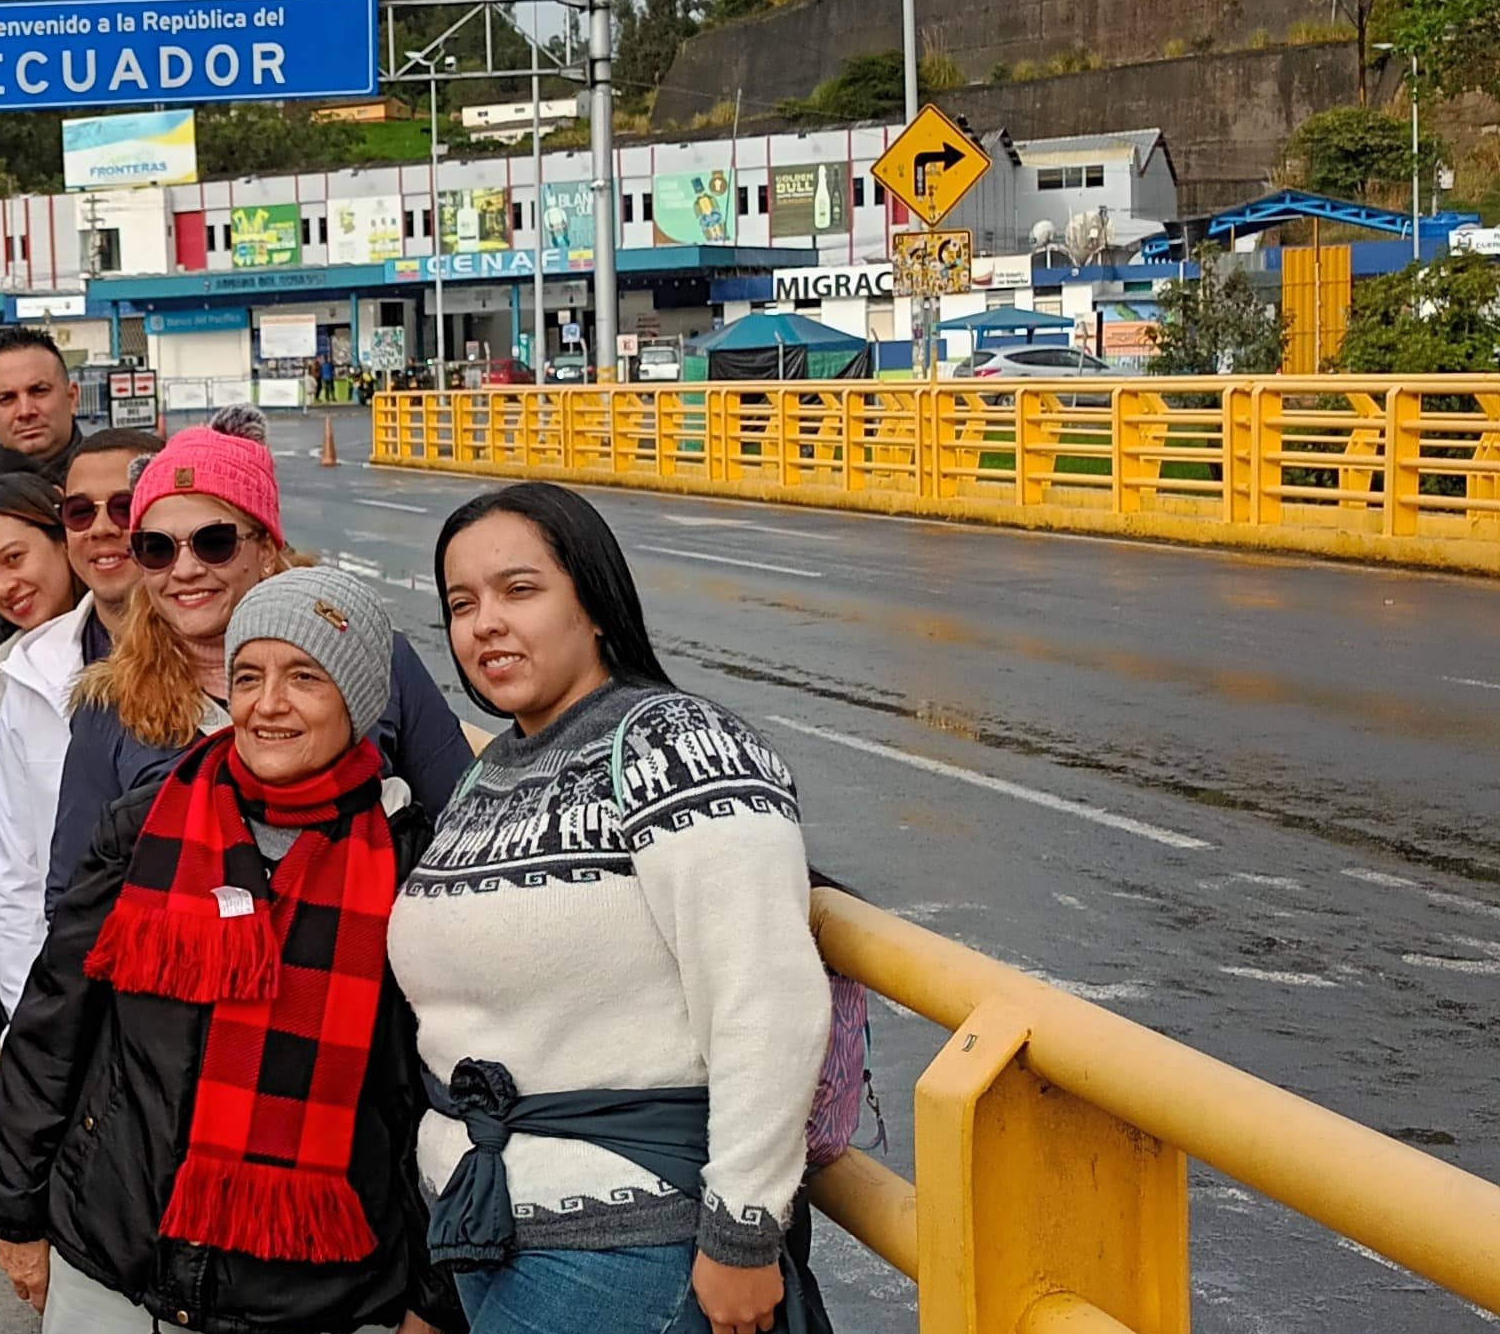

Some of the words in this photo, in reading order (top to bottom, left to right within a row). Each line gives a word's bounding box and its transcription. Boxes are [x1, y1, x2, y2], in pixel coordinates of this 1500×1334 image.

[97, 17, 111, 33] a
[116, 13, 136, 32] la
[142, 9, 246, 35] República
[253, 6, 285, 27] del
[90, 161, 168, 178] FRONTERAS
[426, 248, 560, 274] CENAF
